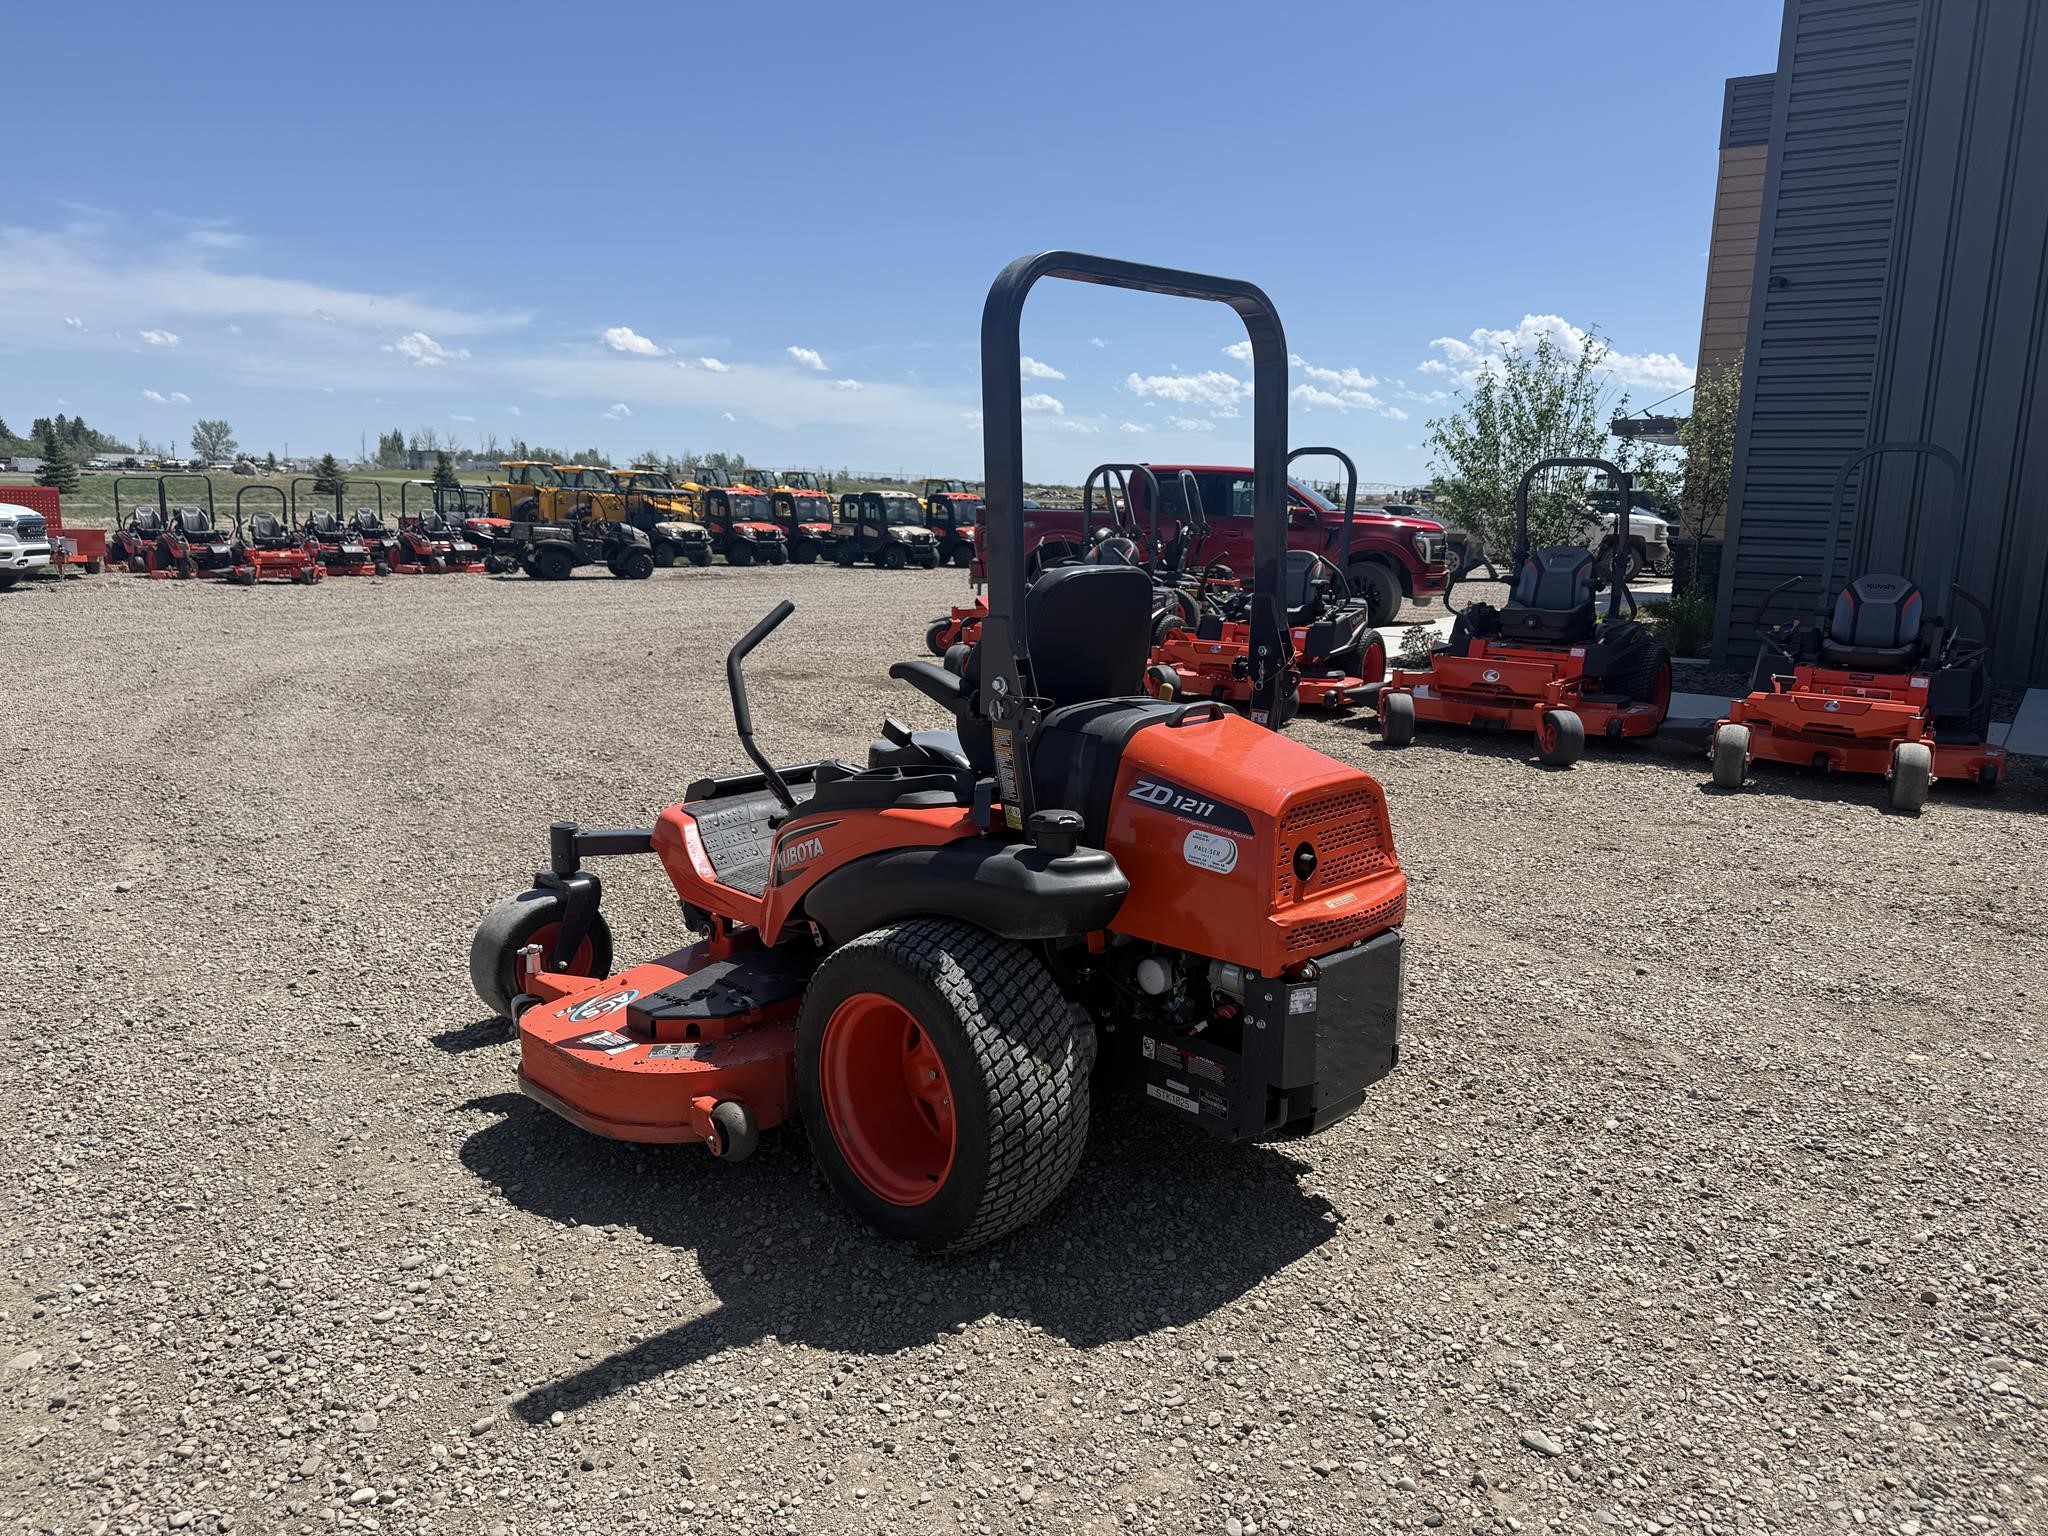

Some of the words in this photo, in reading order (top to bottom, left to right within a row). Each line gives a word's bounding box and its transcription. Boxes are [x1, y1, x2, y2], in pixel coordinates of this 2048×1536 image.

[777, 838, 825, 870] KUBOTA
[580, 992, 630, 1019] ACS
[1155, 1088, 1190, 1109] STK1825
